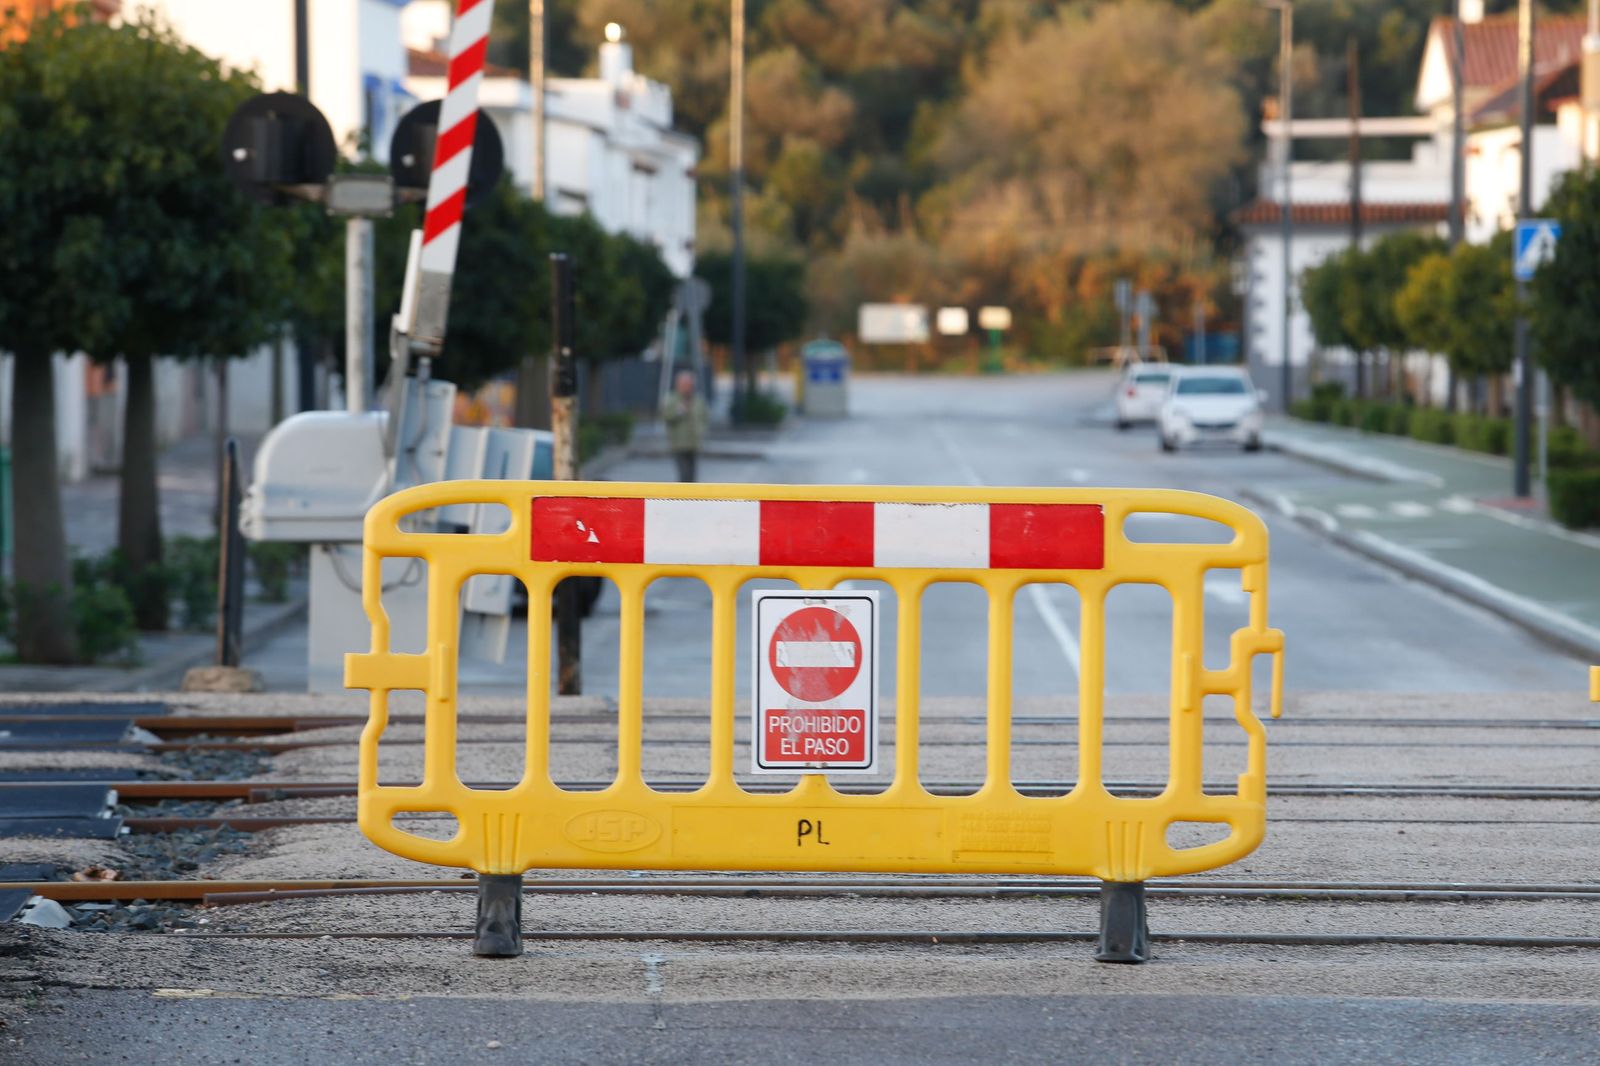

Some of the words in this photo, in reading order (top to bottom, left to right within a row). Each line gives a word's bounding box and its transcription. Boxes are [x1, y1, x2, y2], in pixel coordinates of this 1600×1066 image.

[768, 715, 862, 734] PROHIBIDO
[780, 737, 802, 755] EL
[804, 737, 850, 755] PASO
[573, 817, 647, 843] JSP
[797, 818, 831, 848] PL
